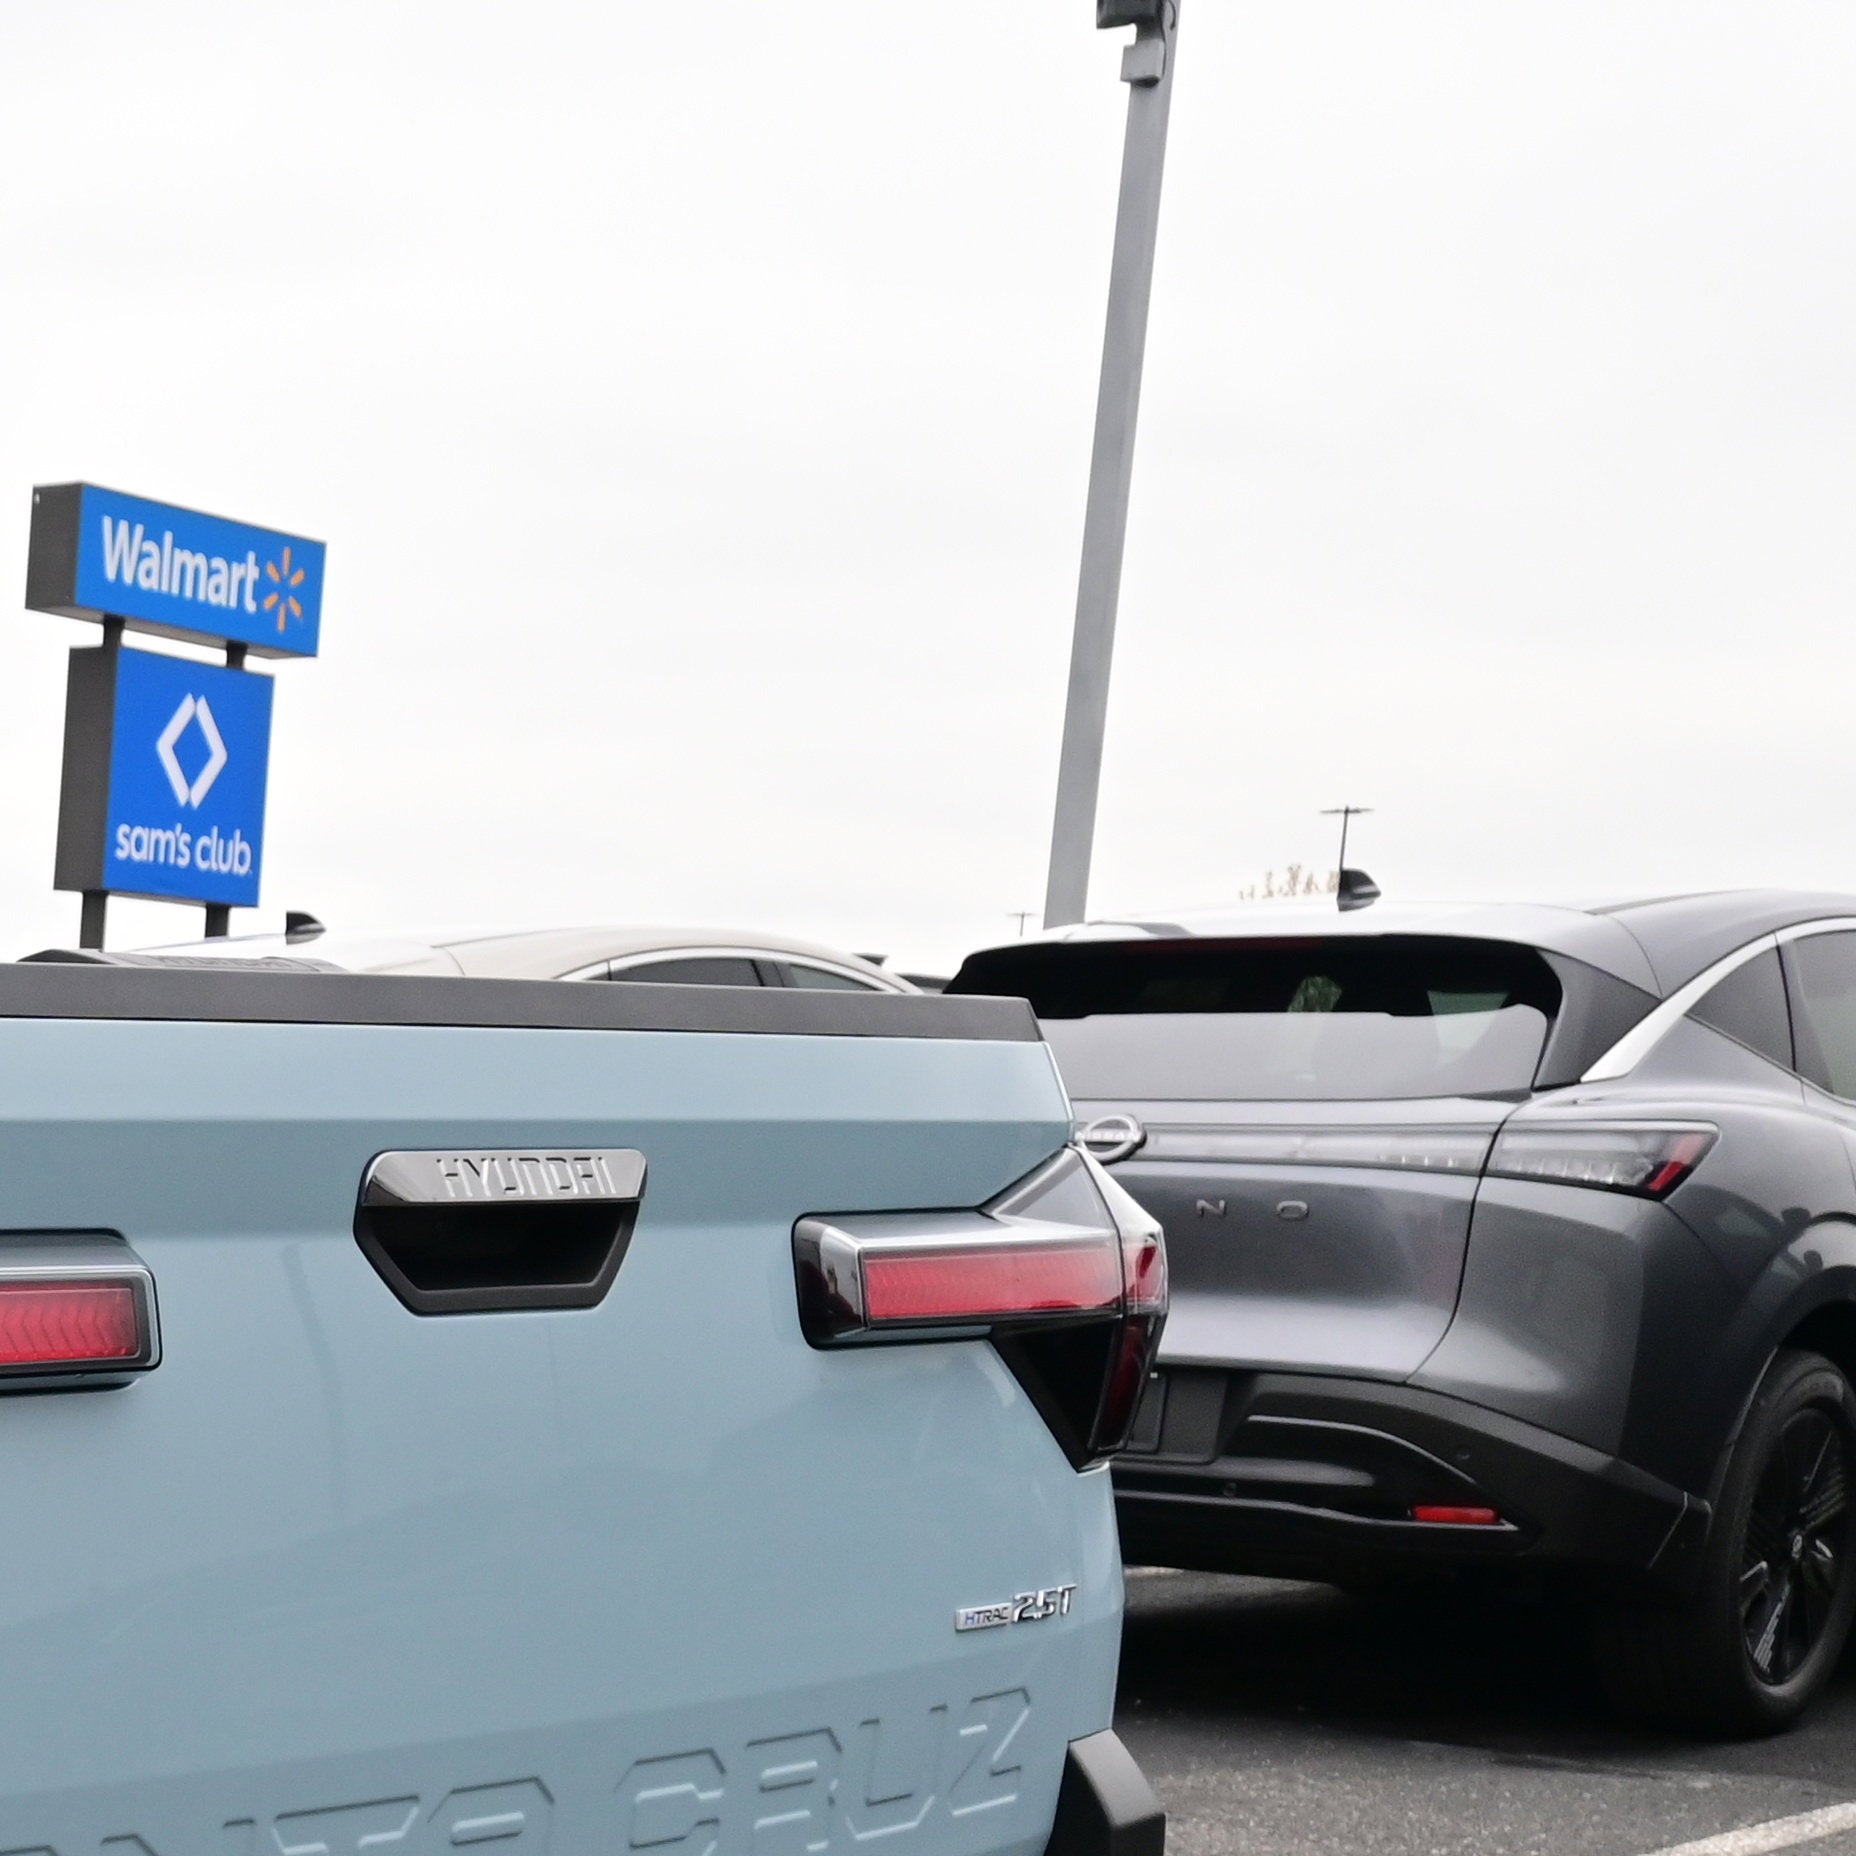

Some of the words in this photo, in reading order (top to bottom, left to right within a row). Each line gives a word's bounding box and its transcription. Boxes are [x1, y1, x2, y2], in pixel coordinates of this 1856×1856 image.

[102, 515, 260, 614] Walmart
[115, 822, 191, 869] sam's
[195, 824, 252, 877] club
[436, 1157, 616, 1198] HYUNDAI
[964, 1606, 1009, 1626] HTRAC
